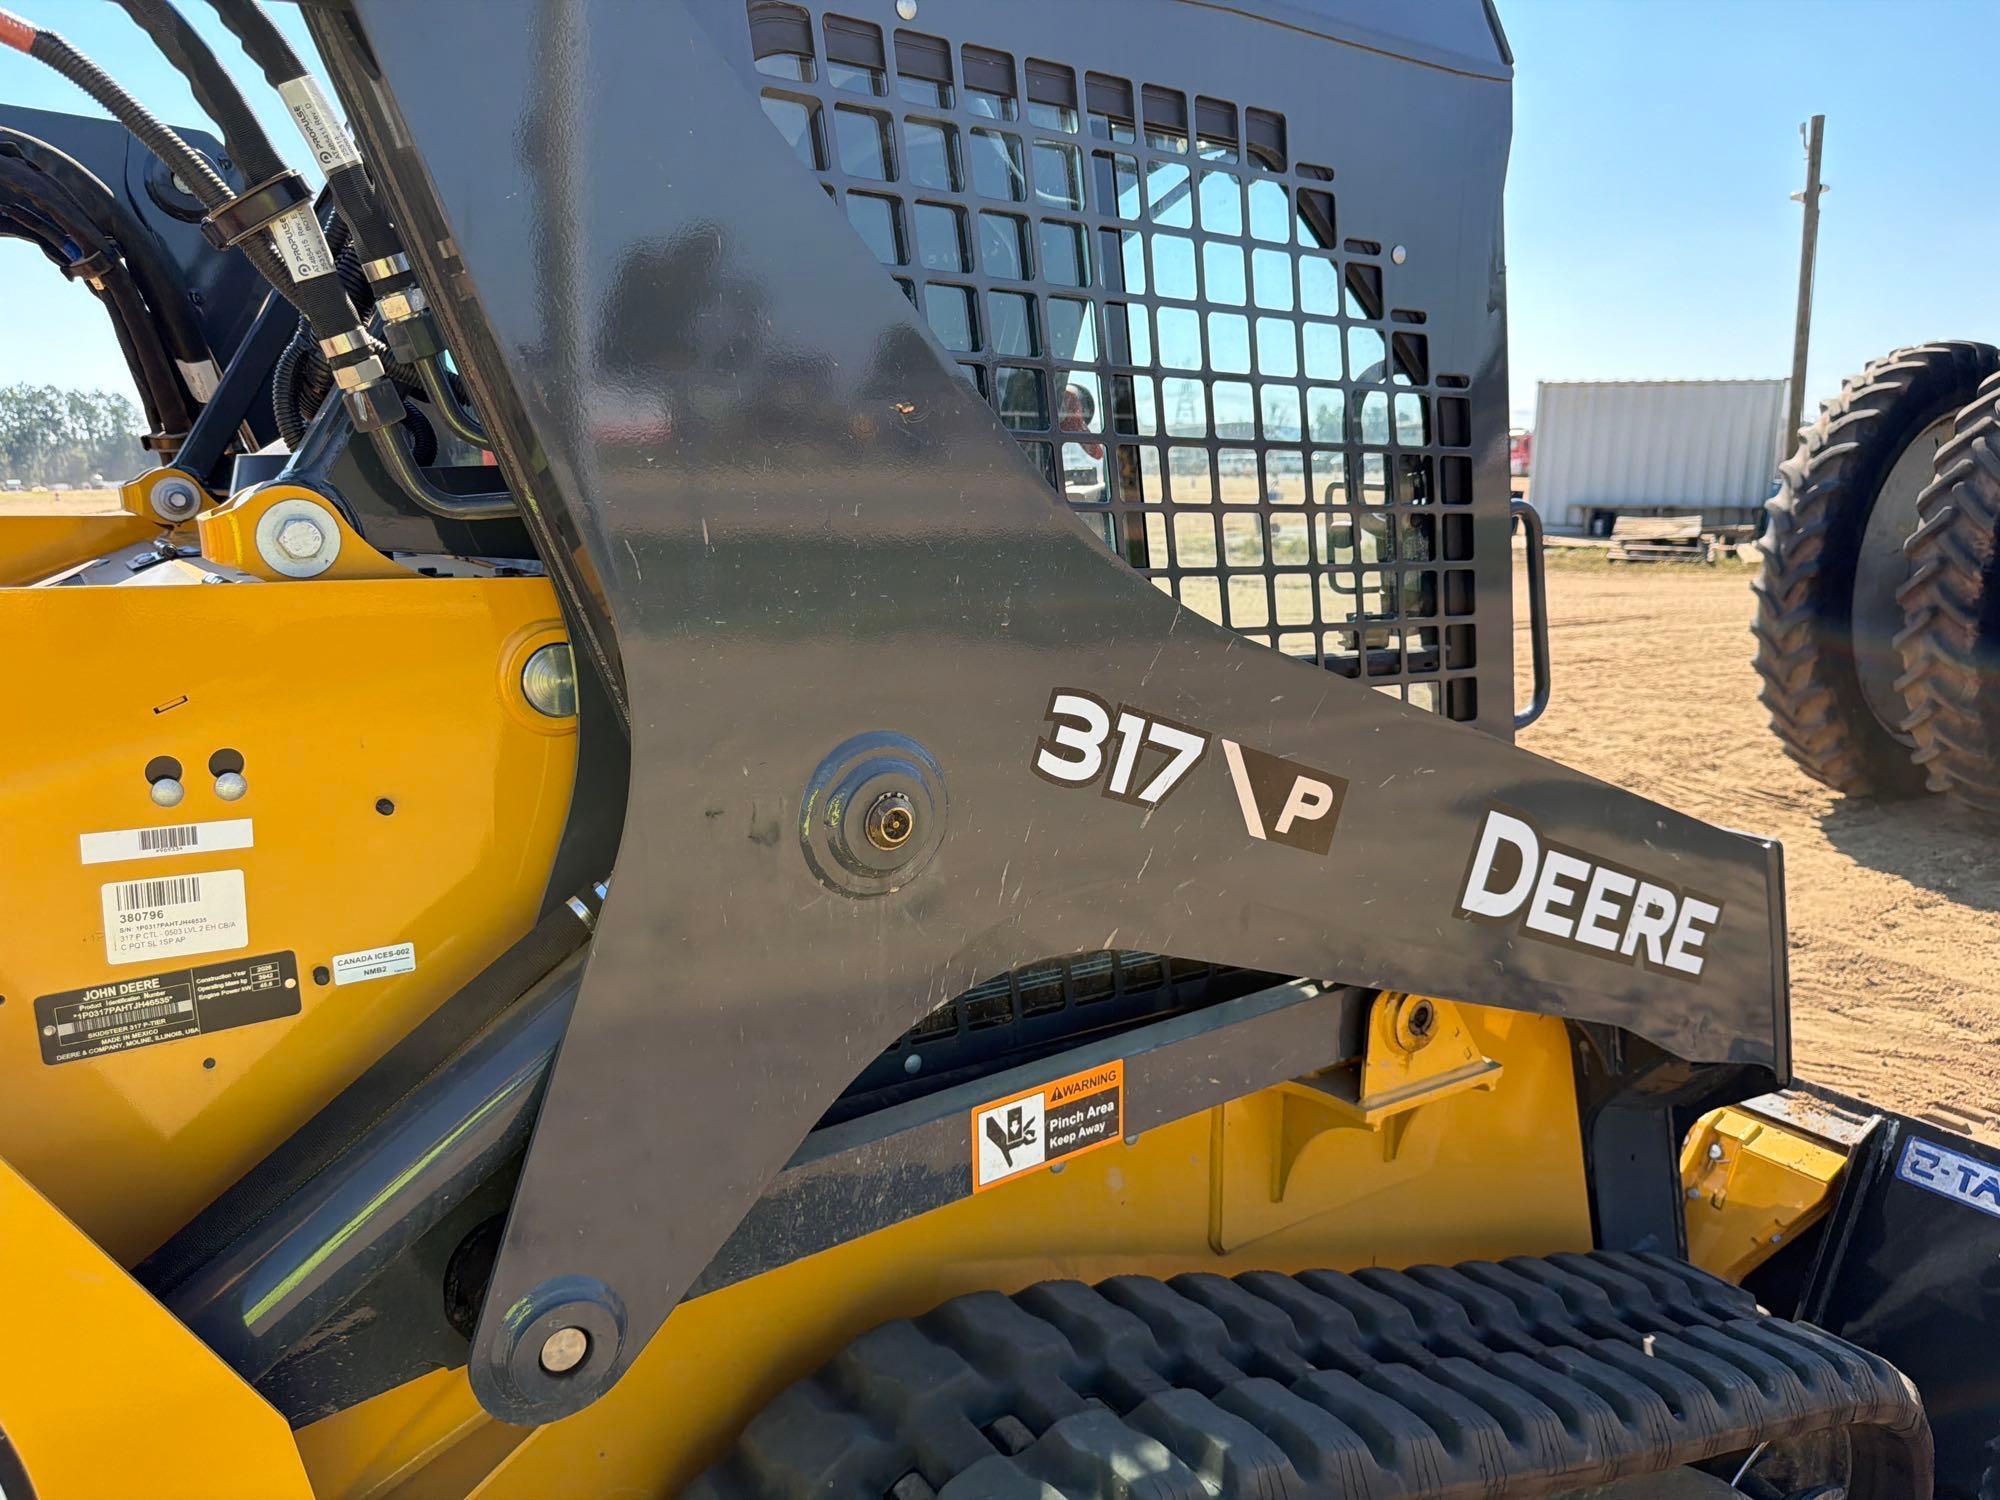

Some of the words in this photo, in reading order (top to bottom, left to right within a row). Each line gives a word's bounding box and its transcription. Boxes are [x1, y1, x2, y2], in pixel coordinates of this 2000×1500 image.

[293, 105, 323, 150] PROPULSE
[280, 216, 304, 262] PROPULSE
[1036, 694, 1205, 803] 317
[1274, 774, 1334, 835] P
[1461, 810, 1720, 974] DEERE
[119, 910, 164, 924] 380796
[121, 933, 135, 943] 317
[135, 932, 142, 941] P
[143, 930, 158, 940] CTL
[164, 928, 182, 938] 0503
[205, 923, 217, 931] EH
[121, 943, 127, 951] C
[147, 940, 158, 948] SL
[174, 936, 186, 945] AP
[337, 954, 373, 967] CANADA
[375, 948, 410, 960] ICES-002
[196, 973, 232, 984] Construction
[364, 966, 388, 976] NMB2
[83, 986, 117, 1001] JOHN
[120, 978, 160, 995] DEERE
[197, 982, 225, 992] Operating
[198, 991, 220, 1000] Engine
[221, 987, 241, 996] Power
[79, 1002, 102, 1011] Product
[106, 995, 141, 1006] Identification
[143, 990, 166, 999] Number
[88, 1026, 128, 1039] SKIDSTEER
[129, 1023, 142, 1032] 317
[143, 1018, 166, 1029] P-TIER
[101, 1036, 121, 1045] MADE
[132, 1029, 159, 1041] MEXICO
[56, 1050, 81, 1061] DEERE
[88, 1042, 125, 1055] COMPANY,
[126, 1038, 153, 1048] MOLINE,
[1062, 1070, 1117, 1097] WARNING
[1049, 1110, 1084, 1133] Pinch
[1086, 1100, 1115, 1119] Area
[1049, 1132, 1076, 1149] Keep
[1078, 1119, 1106, 1140] Away
